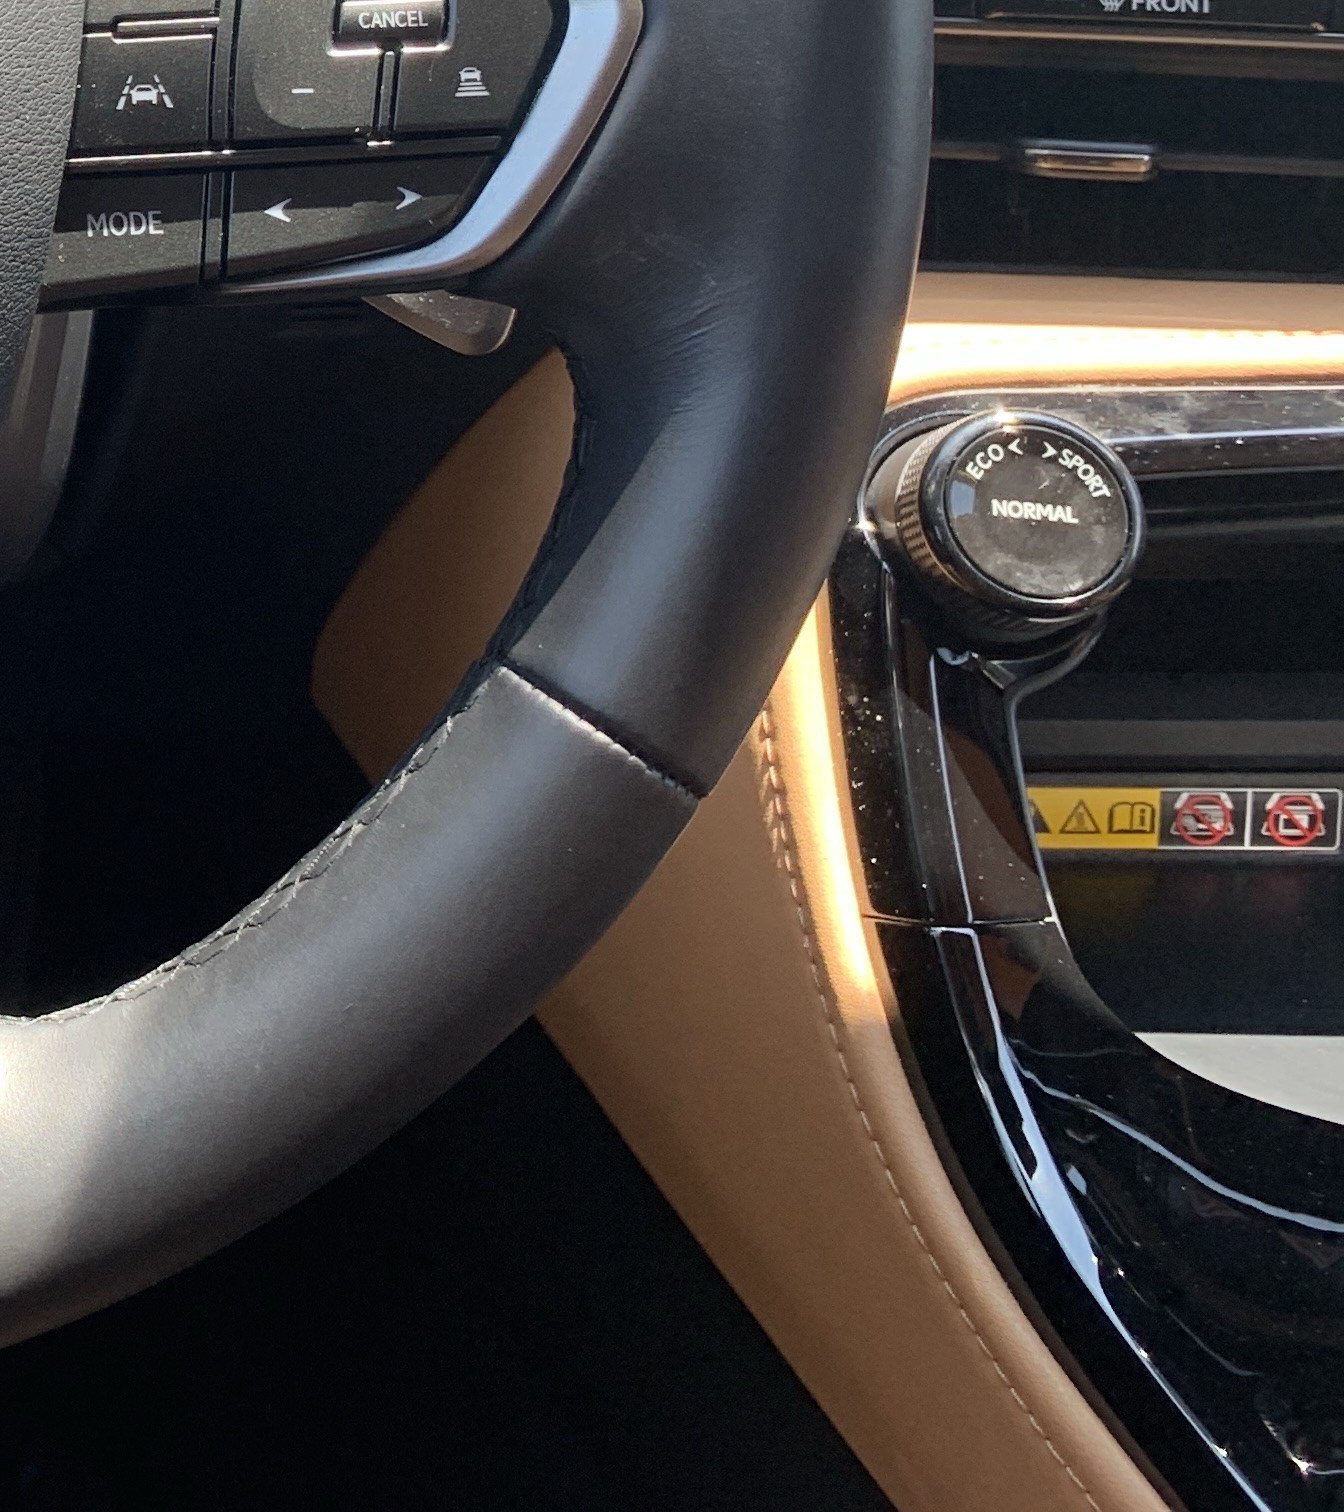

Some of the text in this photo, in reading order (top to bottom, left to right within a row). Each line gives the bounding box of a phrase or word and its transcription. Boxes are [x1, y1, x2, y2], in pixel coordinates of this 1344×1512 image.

[358, 10, 429, 30] CANCEL
[86, 210, 165, 238] MODE
[965, 443, 1005, 480] ECO
[1058, 448, 1112, 498] SPORT
[991, 498, 1080, 524] NORMAL
